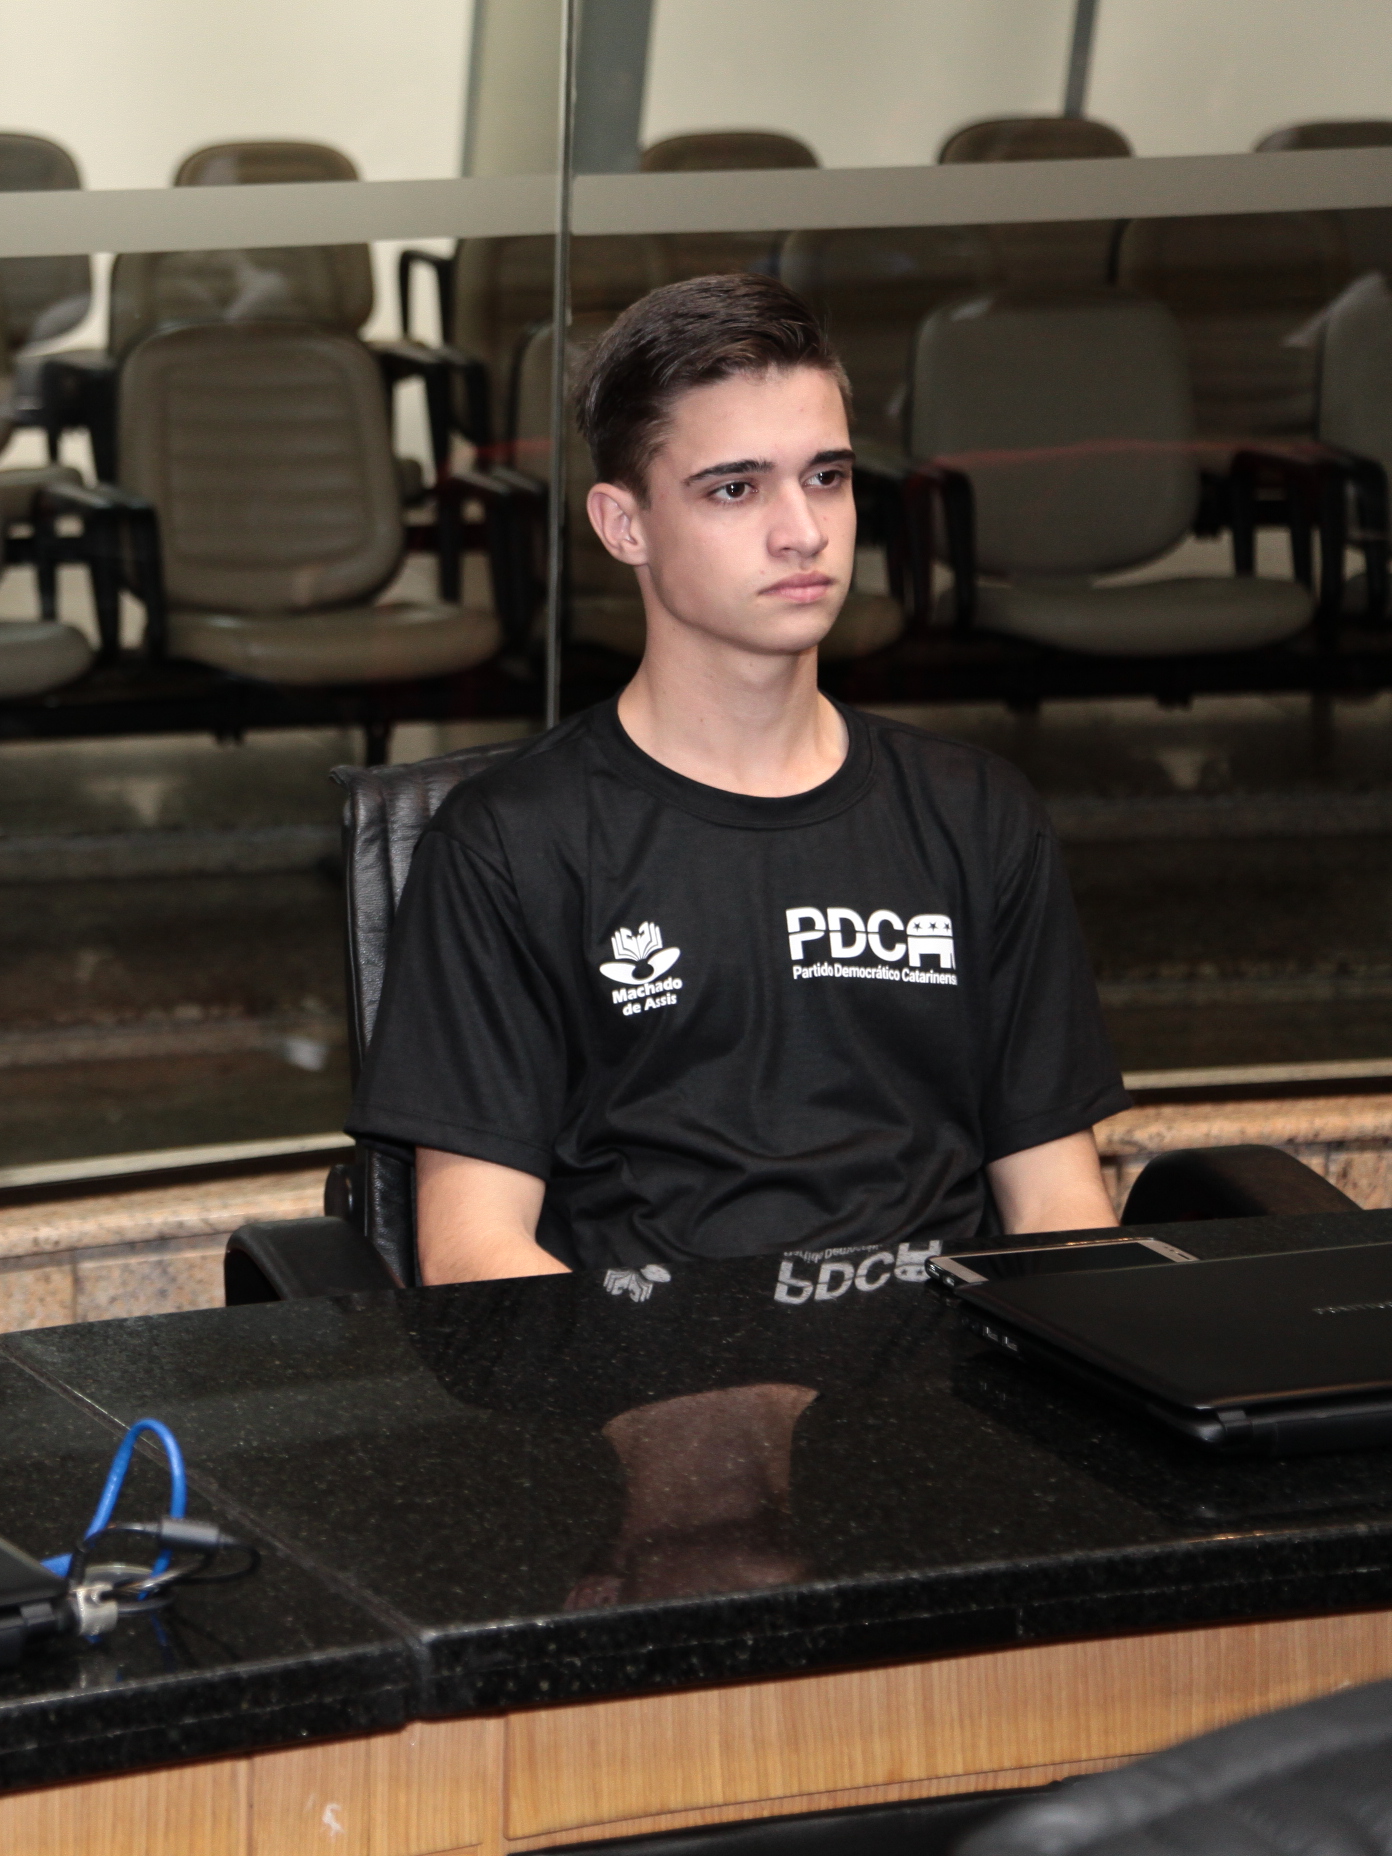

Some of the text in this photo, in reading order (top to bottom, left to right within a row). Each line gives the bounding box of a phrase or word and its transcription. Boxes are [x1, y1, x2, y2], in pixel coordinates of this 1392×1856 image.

[792, 961, 958, 986] Partido Democrático Catarinens
[612, 976, 683, 1005] Machado
[622, 992, 678, 1017] de Assis
